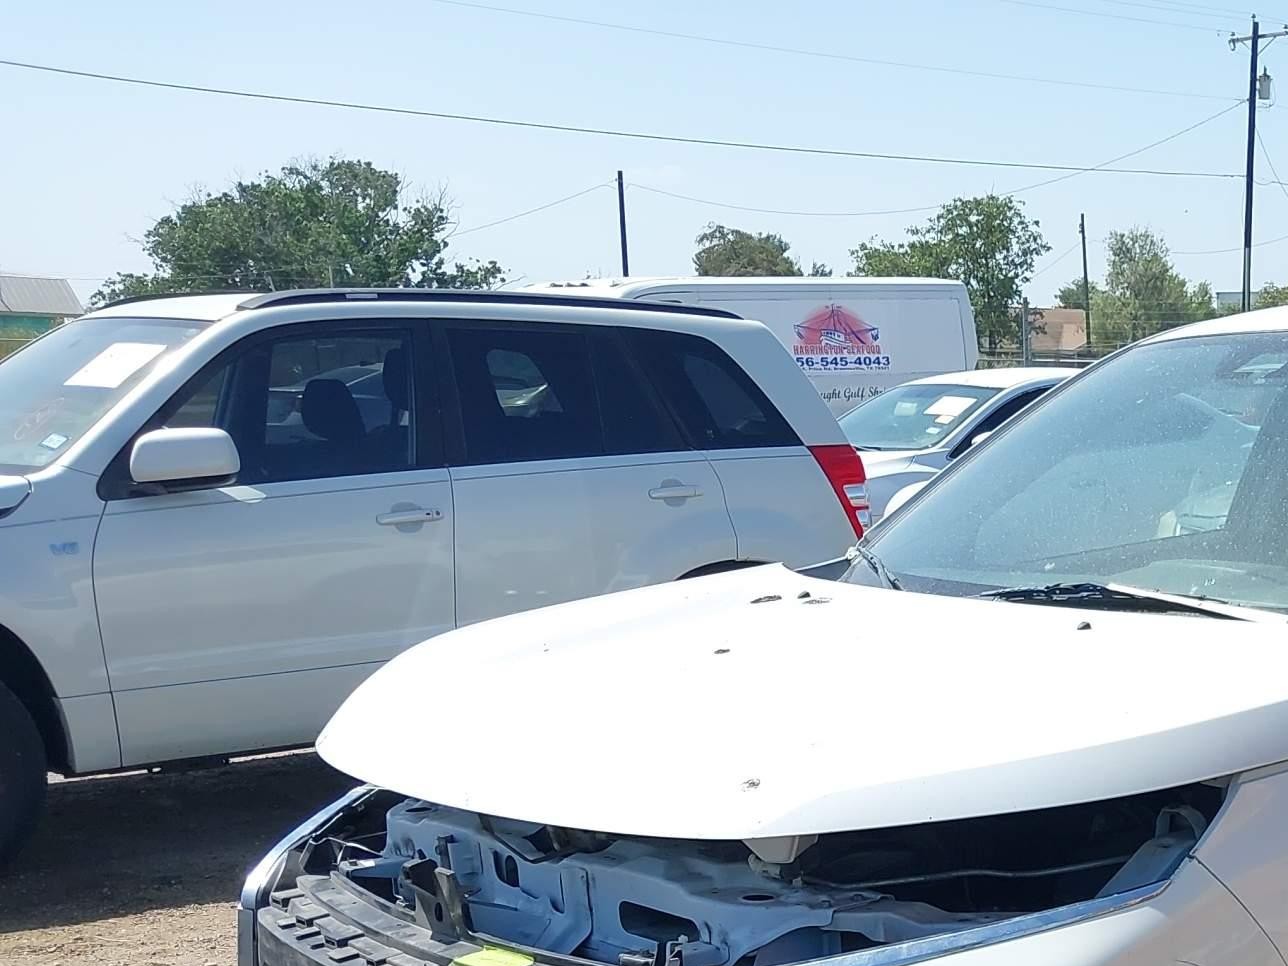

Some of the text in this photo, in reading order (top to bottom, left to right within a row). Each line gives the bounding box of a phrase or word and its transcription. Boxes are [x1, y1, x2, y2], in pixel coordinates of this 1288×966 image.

[793, 344, 881, 355] HARRINGTON SEAFOOD
[796, 356, 890, 367] 56-545-4043
[820, 387, 841, 402] ught
[843, 386, 865, 402] Gulf
